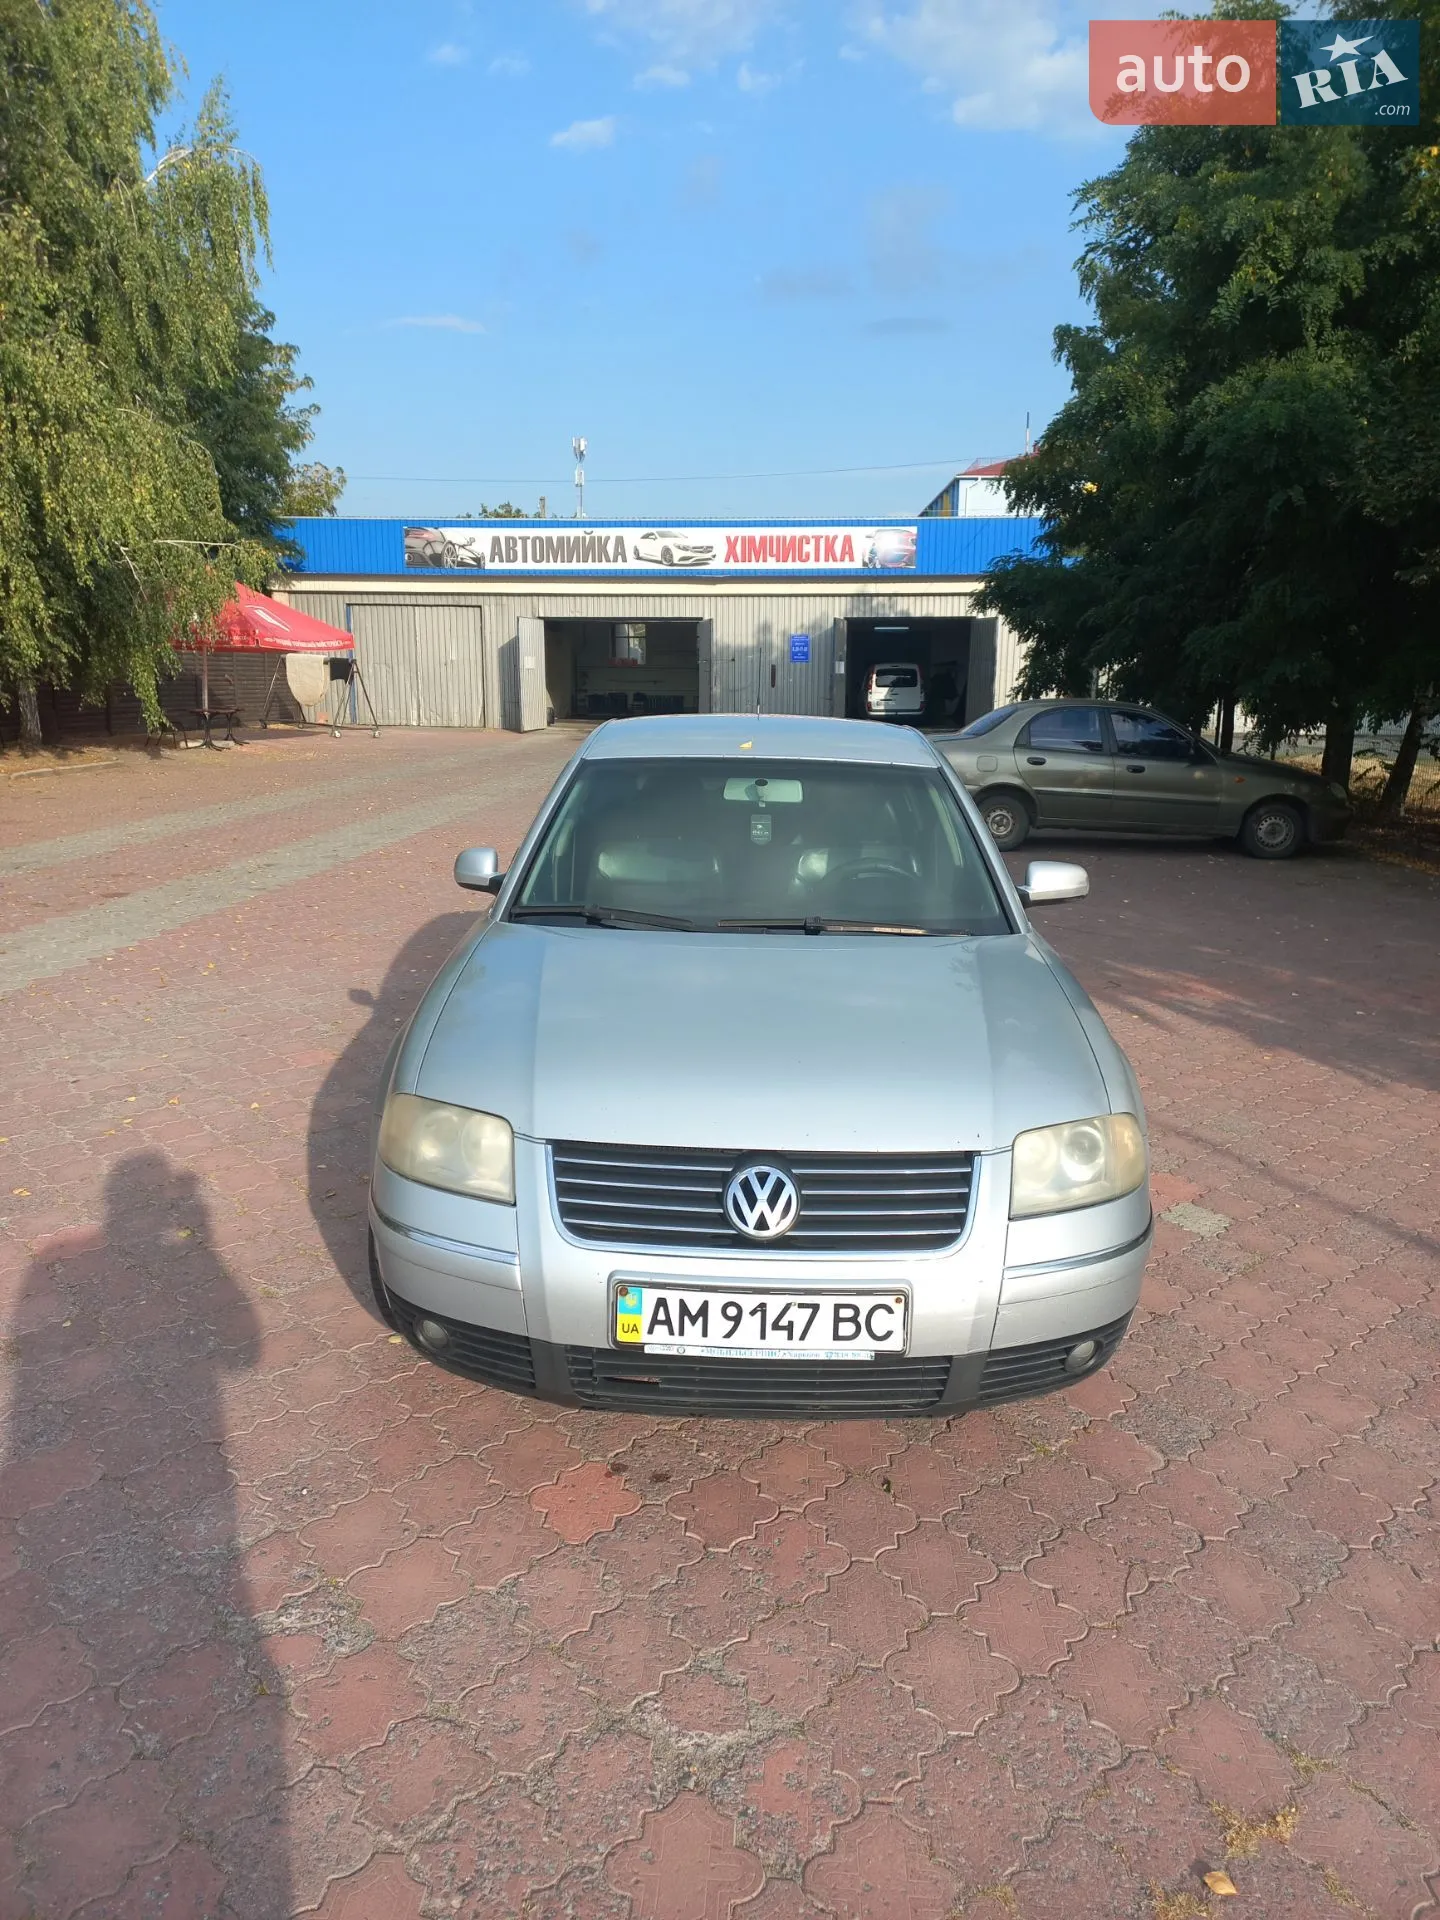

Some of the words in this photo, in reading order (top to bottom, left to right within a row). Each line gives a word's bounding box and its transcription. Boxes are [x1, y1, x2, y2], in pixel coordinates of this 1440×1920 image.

[489, 530, 627, 563] АВТОМИЙКА
[724, 534, 855, 563] ХІМЧИСТКА
[726, 1165, 798, 1238] VW
[622, 1324, 641, 1335] UA
[647, 1297, 710, 1339] AM
[720, 1301, 820, 1342] 9147
[833, 1303, 894, 1342] BC
